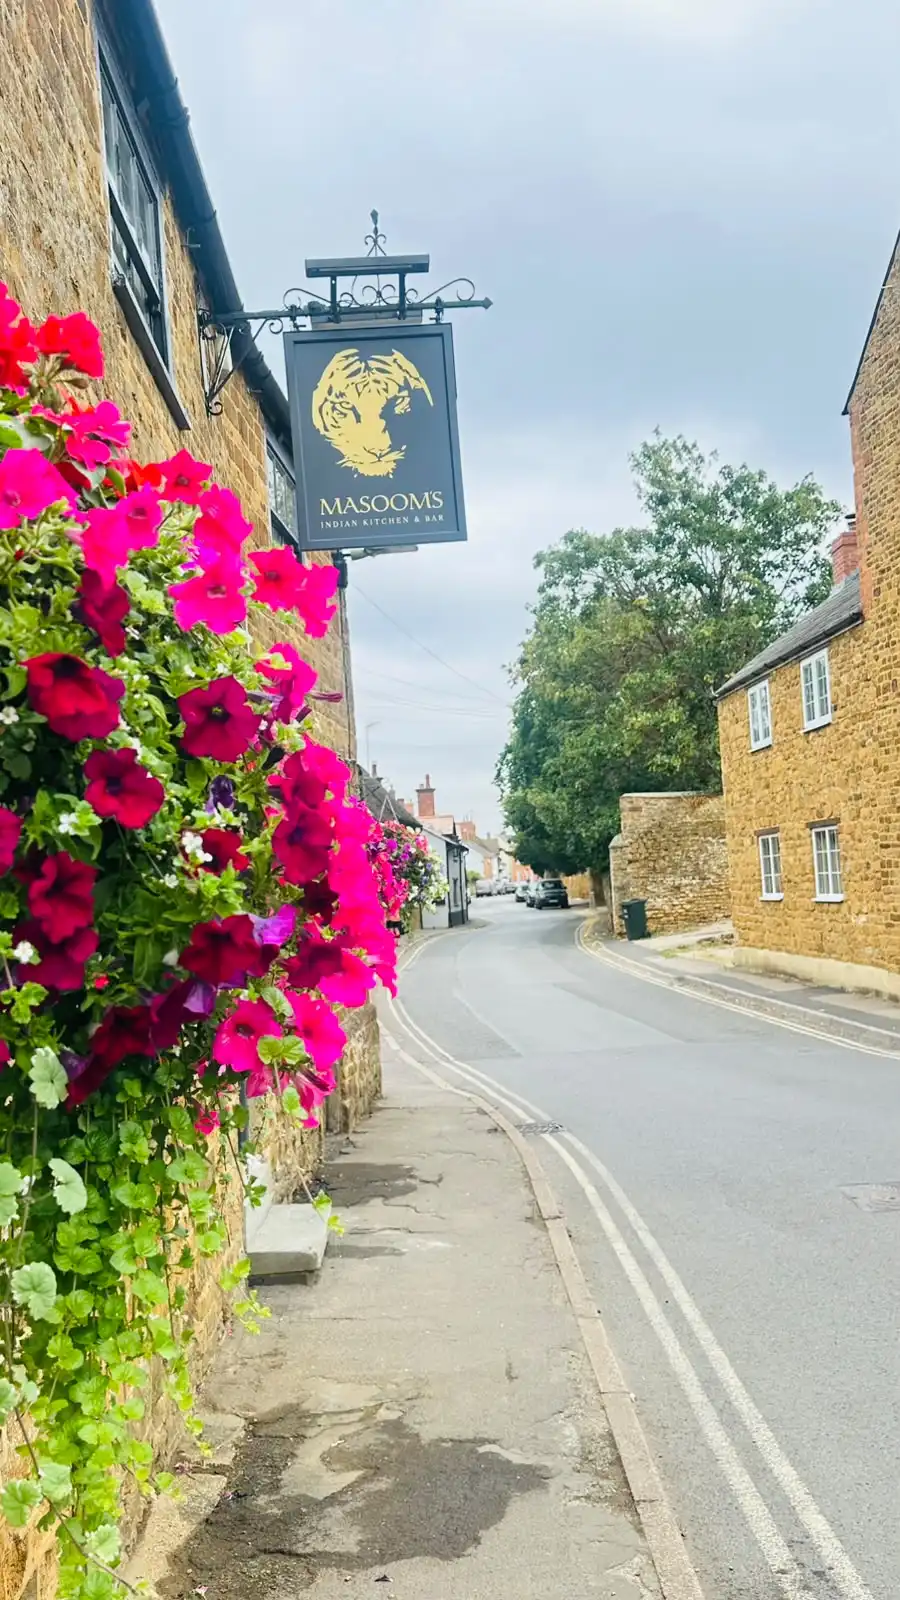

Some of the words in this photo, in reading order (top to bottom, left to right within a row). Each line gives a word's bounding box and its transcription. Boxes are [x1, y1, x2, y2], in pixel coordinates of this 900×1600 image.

[320, 491, 444, 515] MASOOM'S
[320, 519, 358, 529] INDIAN
[363, 516, 409, 526] KITCHEN
[414, 515, 420, 523] &
[425, 514, 444, 522] BAR
